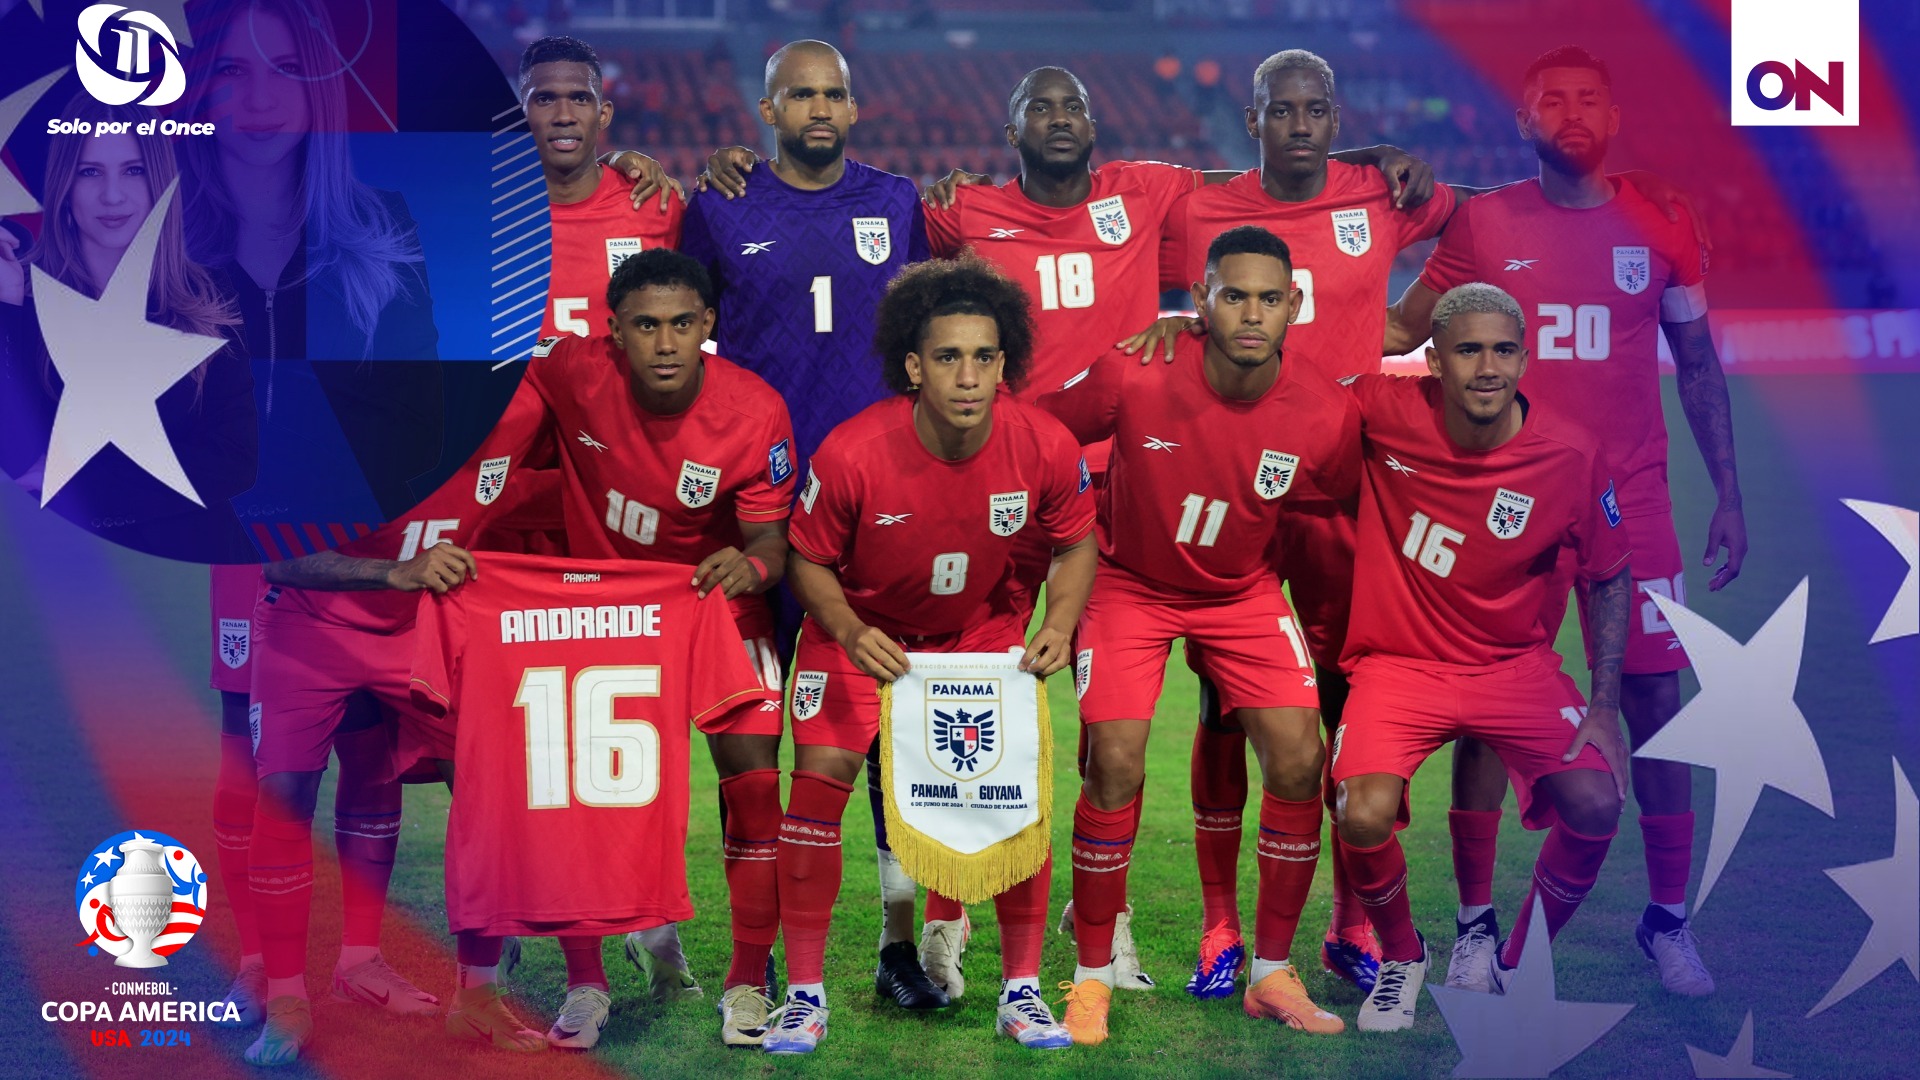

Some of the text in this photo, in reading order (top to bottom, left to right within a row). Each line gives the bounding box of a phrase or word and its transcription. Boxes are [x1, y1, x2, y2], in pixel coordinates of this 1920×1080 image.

[810, 275, 833, 332] 1
[1035, 252, 1095, 310] 18
[1537, 303, 1612, 361] 20
[397, 518, 461, 562] 15
[605, 487, 660, 545] 10
[1175, 492, 1230, 547] 11
[1402, 510, 1467, 578] 16
[930, 552, 970, 595] 8
[500, 604, 662, 644] ANDRADE
[932, 682, 994, 695] PANAMÁ
[512, 664, 662, 809] 16
[911, 783, 958, 799] PANAMÁ
[979, 785, 1022, 800] GUYANA
